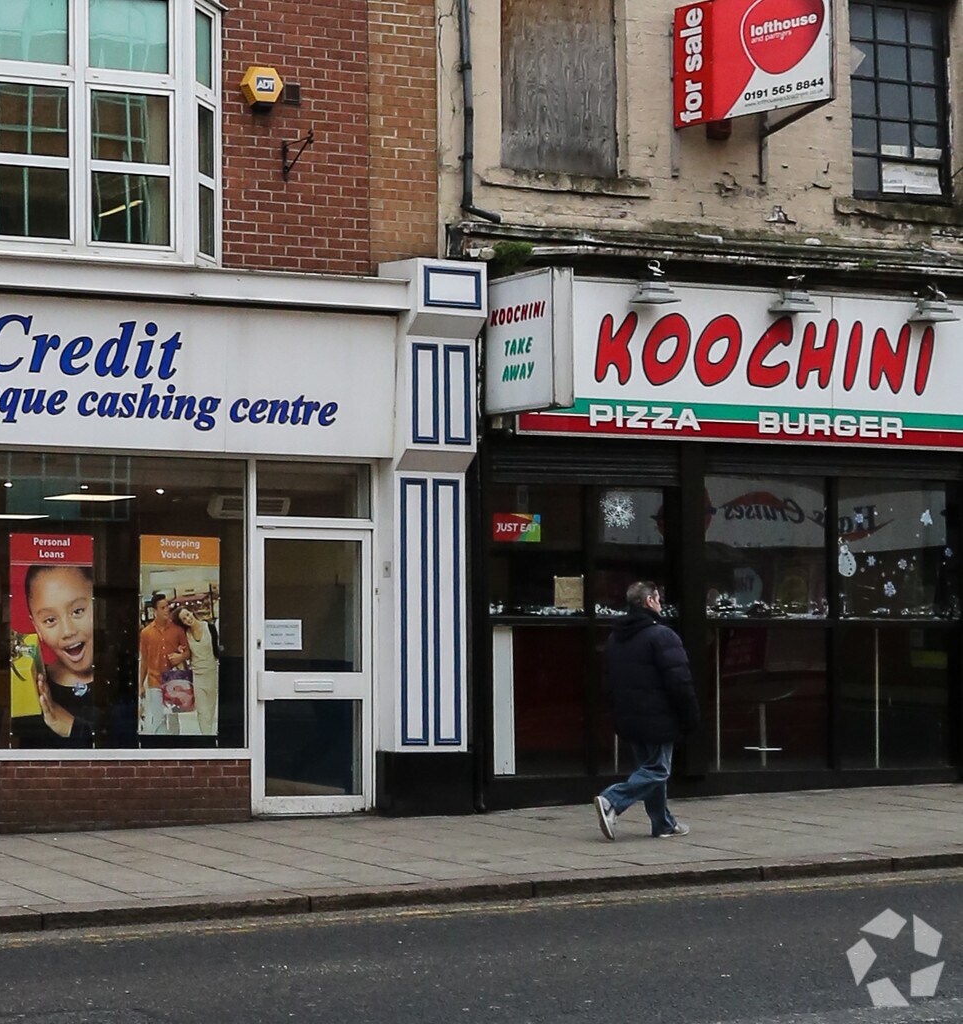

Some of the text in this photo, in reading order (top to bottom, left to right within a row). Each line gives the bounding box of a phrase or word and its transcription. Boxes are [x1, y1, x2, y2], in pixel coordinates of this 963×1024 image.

[750, 13, 818, 37] lofthouse
[750, 35, 764, 44] and
[679, 7, 704, 124] for sale
[256, 79, 275, 91] ADT
[744, 89, 768, 101] 0191
[772, 83, 793, 96] 565
[796, 77, 824, 91] 8844
[489, 300, 546, 327] KOOCHINI
[504, 336, 533, 357] TAKE
[594, 311, 935, 396] KOOCHINI
[501, 361, 535, 382] AWAY
[77, 383, 221, 431] cashing
[228, 394, 339, 427] centre
[589, 403, 904, 439] PIZZA BURGER
[496, 522, 537, 533] JUST EAT
[33, 537, 71, 547] Personal
[160, 538, 201, 549] Shopping
[39, 549, 65, 559] Loans
[161, 550, 200, 560] Vouchers
